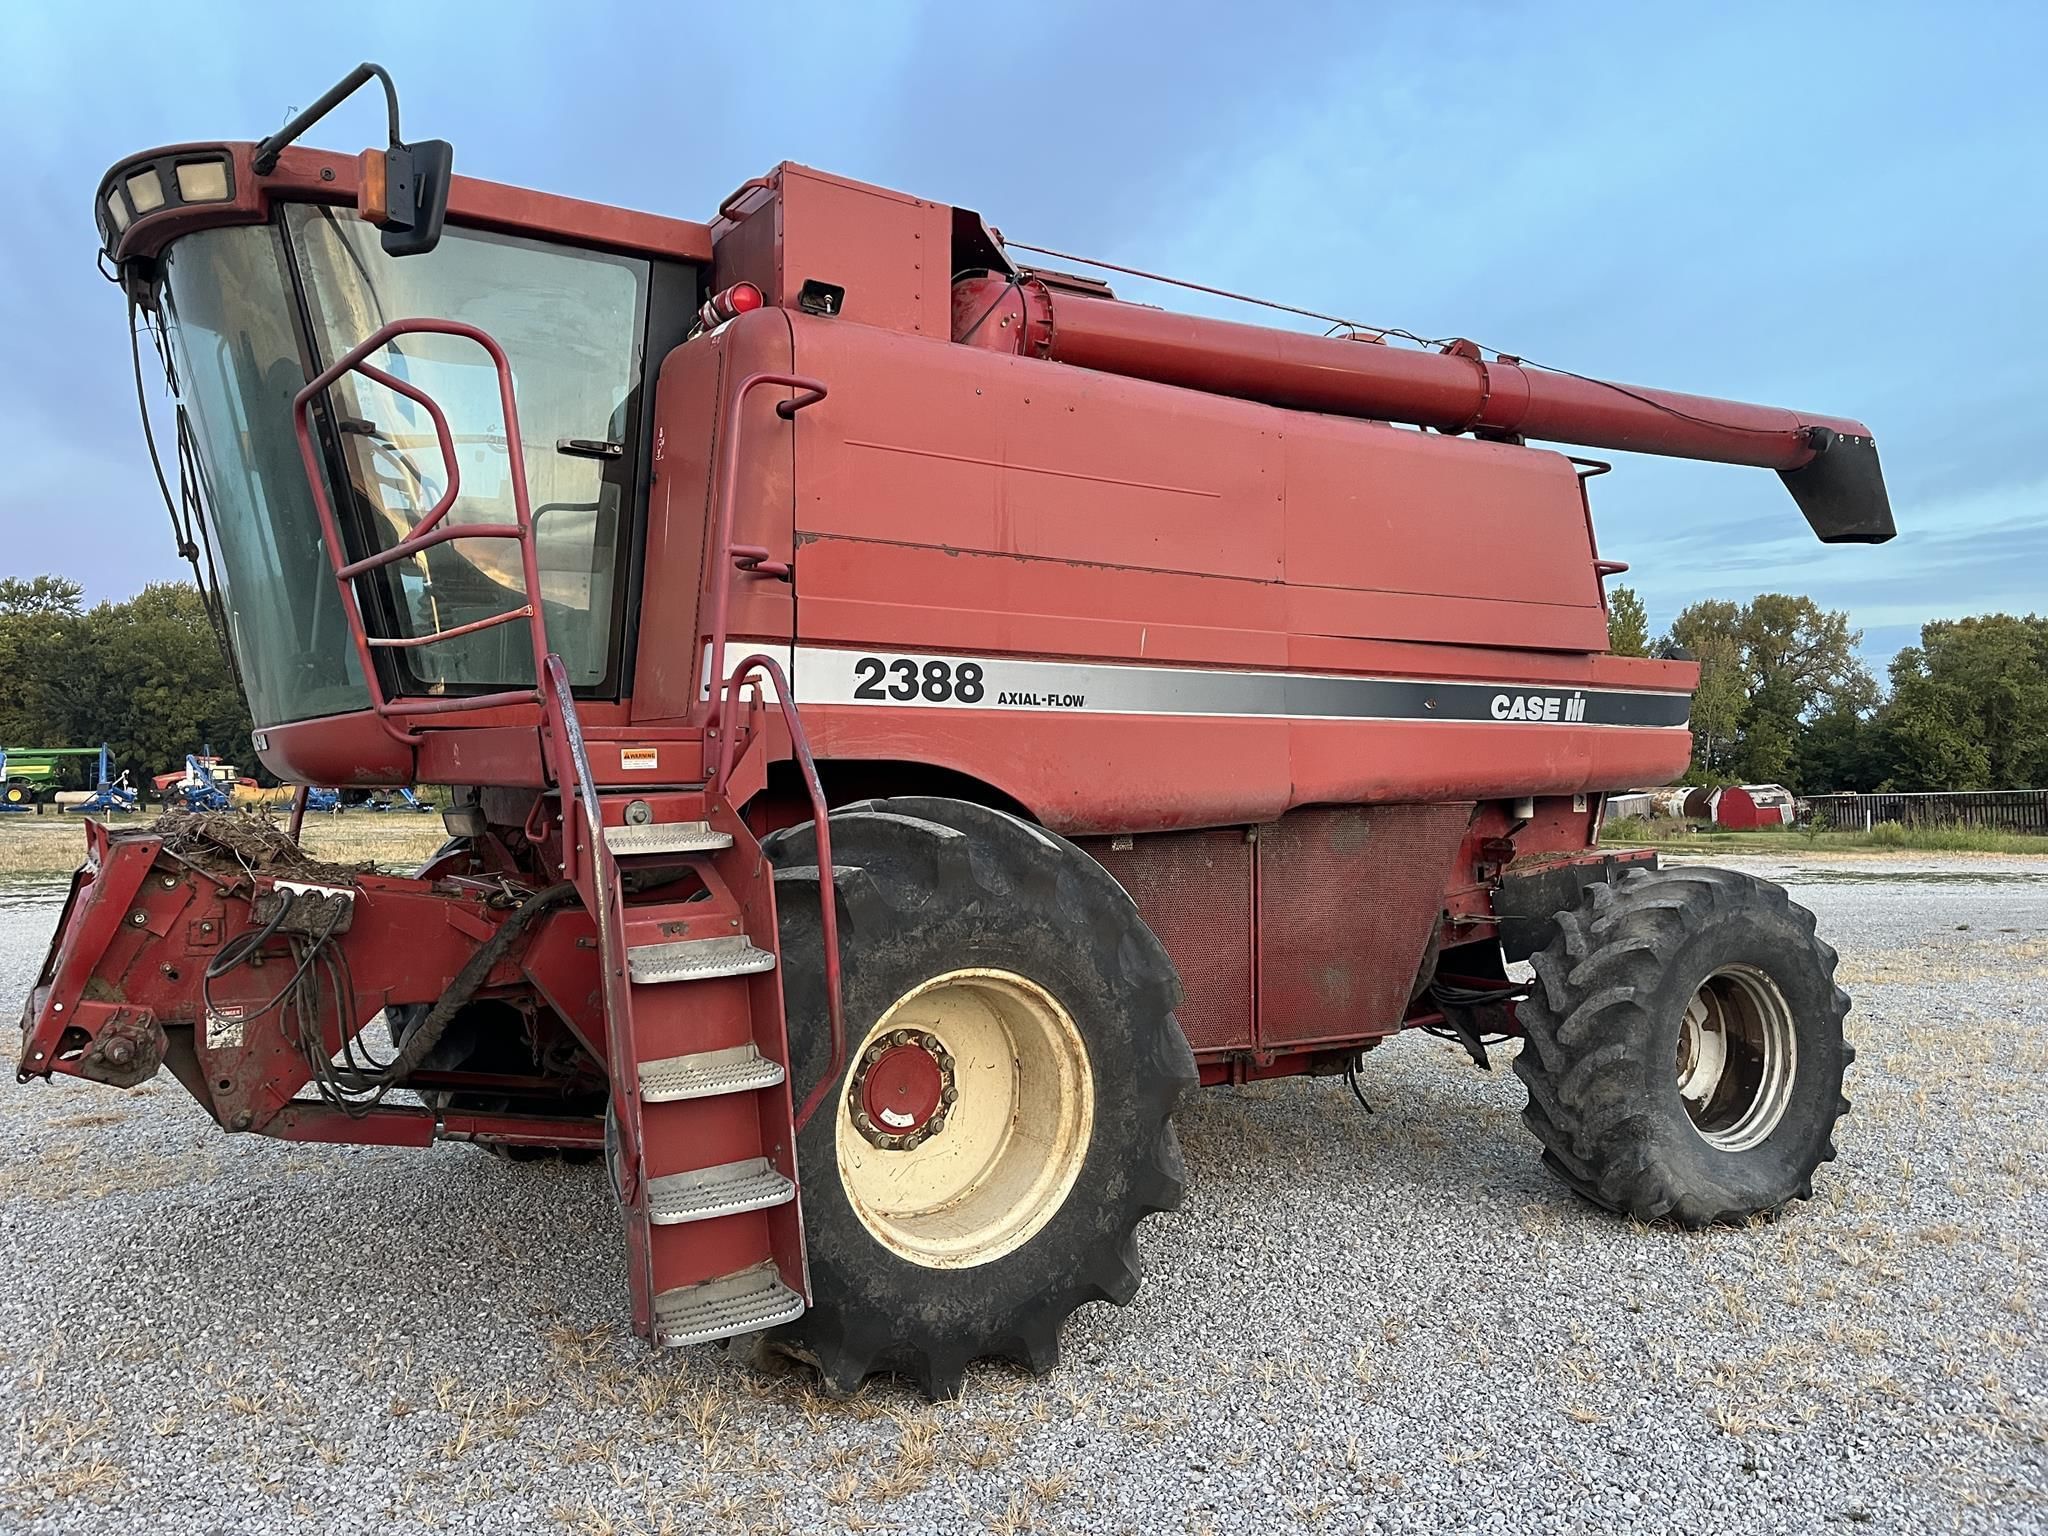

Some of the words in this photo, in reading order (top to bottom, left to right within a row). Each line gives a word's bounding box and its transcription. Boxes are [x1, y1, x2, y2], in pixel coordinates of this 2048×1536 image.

[854, 657, 984, 703] 2388
[998, 692, 1084, 707] AXIAL-FLOW
[1491, 694, 1561, 720] CASE
[631, 752, 655, 760] WARNING
